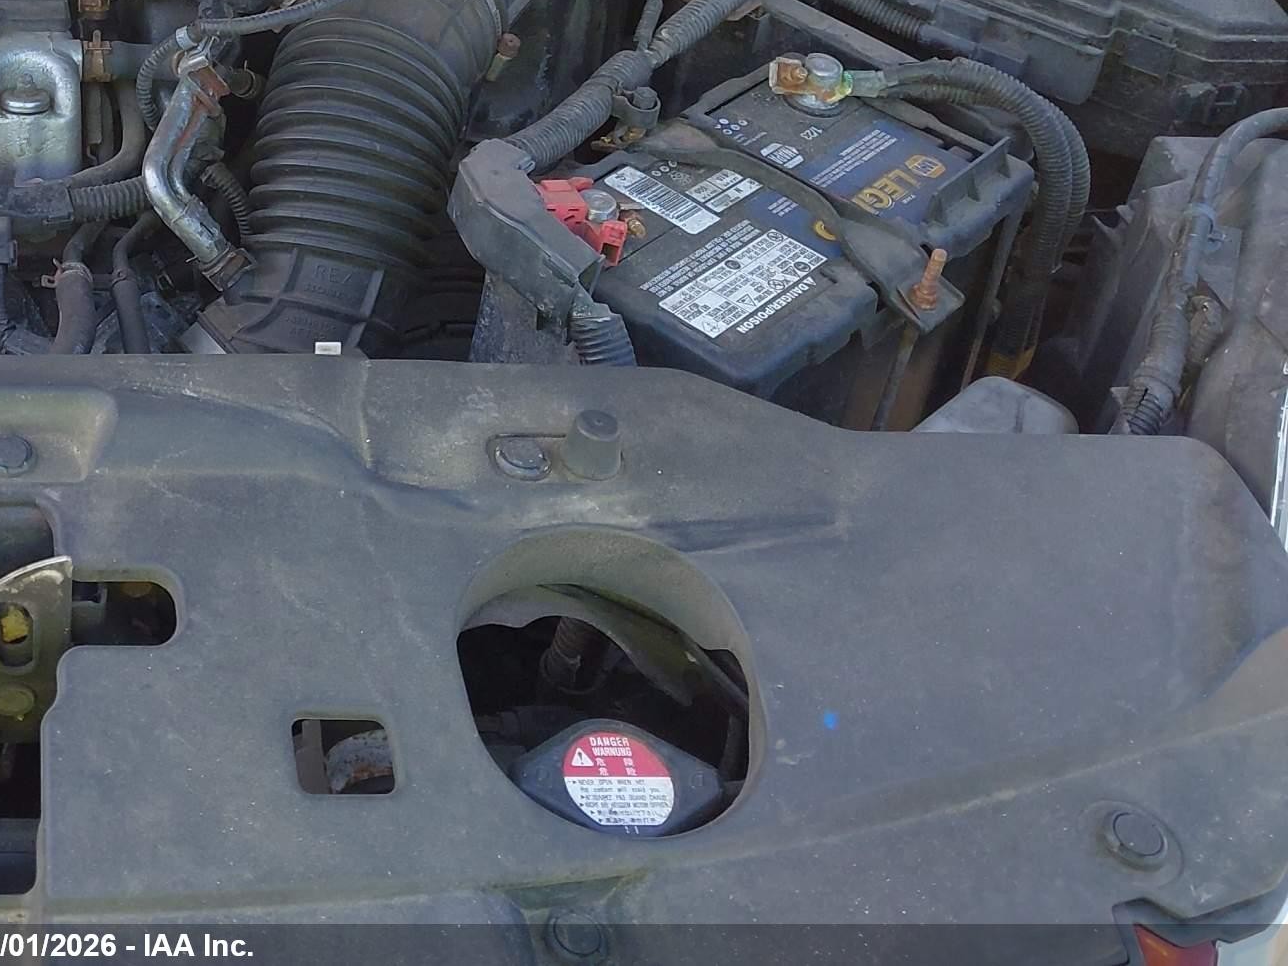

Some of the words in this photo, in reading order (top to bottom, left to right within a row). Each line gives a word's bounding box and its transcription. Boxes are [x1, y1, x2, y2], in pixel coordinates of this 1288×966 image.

[800, 126, 823, 140] 1/23
[771, 144, 796, 166] NAPA
[589, 737, 630, 747] DANGER
